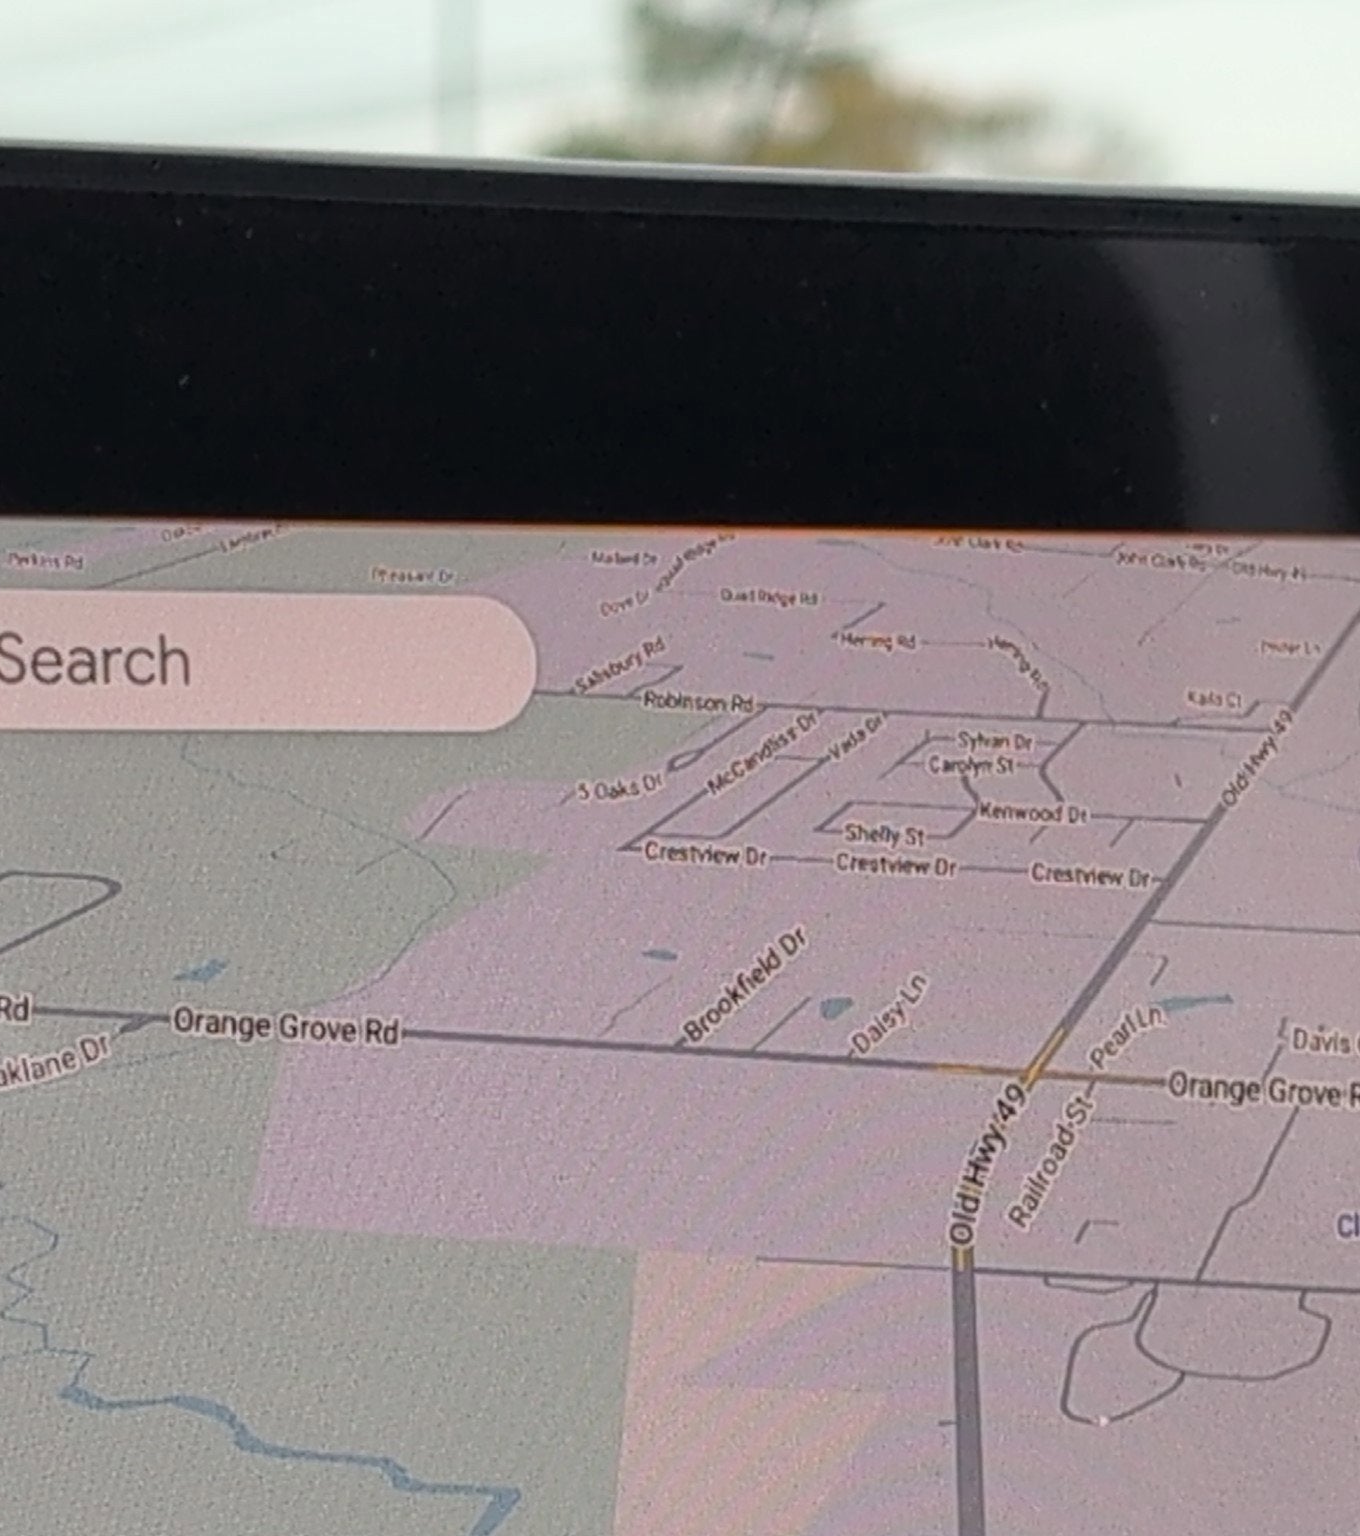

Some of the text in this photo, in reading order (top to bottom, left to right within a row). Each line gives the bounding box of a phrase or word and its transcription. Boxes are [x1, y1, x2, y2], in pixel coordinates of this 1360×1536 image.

[643, 690, 755, 713] Robinson Rd
[796, 711, 817, 735] Dr
[1015, 734, 1033, 750] Dr
[929, 756, 1014, 777] Carolyn St
[980, 803, 1088, 823] Kenwood Dr
[905, 827, 925, 846] St
[644, 841, 767, 866] Crestview Dr
[837, 854, 957, 877] Crestview Dr
[1031, 863, 1151, 888] Crestview Dr
[683, 927, 806, 1043] Brookfield Dr
[173, 1006, 399, 1045] Orange Grove Rd
[851, 974, 927, 1055] Daisy Ln
[80, 1034, 112, 1063] Dr
[1090, 1007, 1162, 1070] Pearl Ln
[1292, 1026, 1350, 1055] Davis
[1168, 1070, 1261, 1105] Orange
[1268, 1077, 1340, 1106] Grove
[949, 1083, 1027, 1245] Old Hwy 49
[1007, 1096, 1094, 1229] Railroad St
